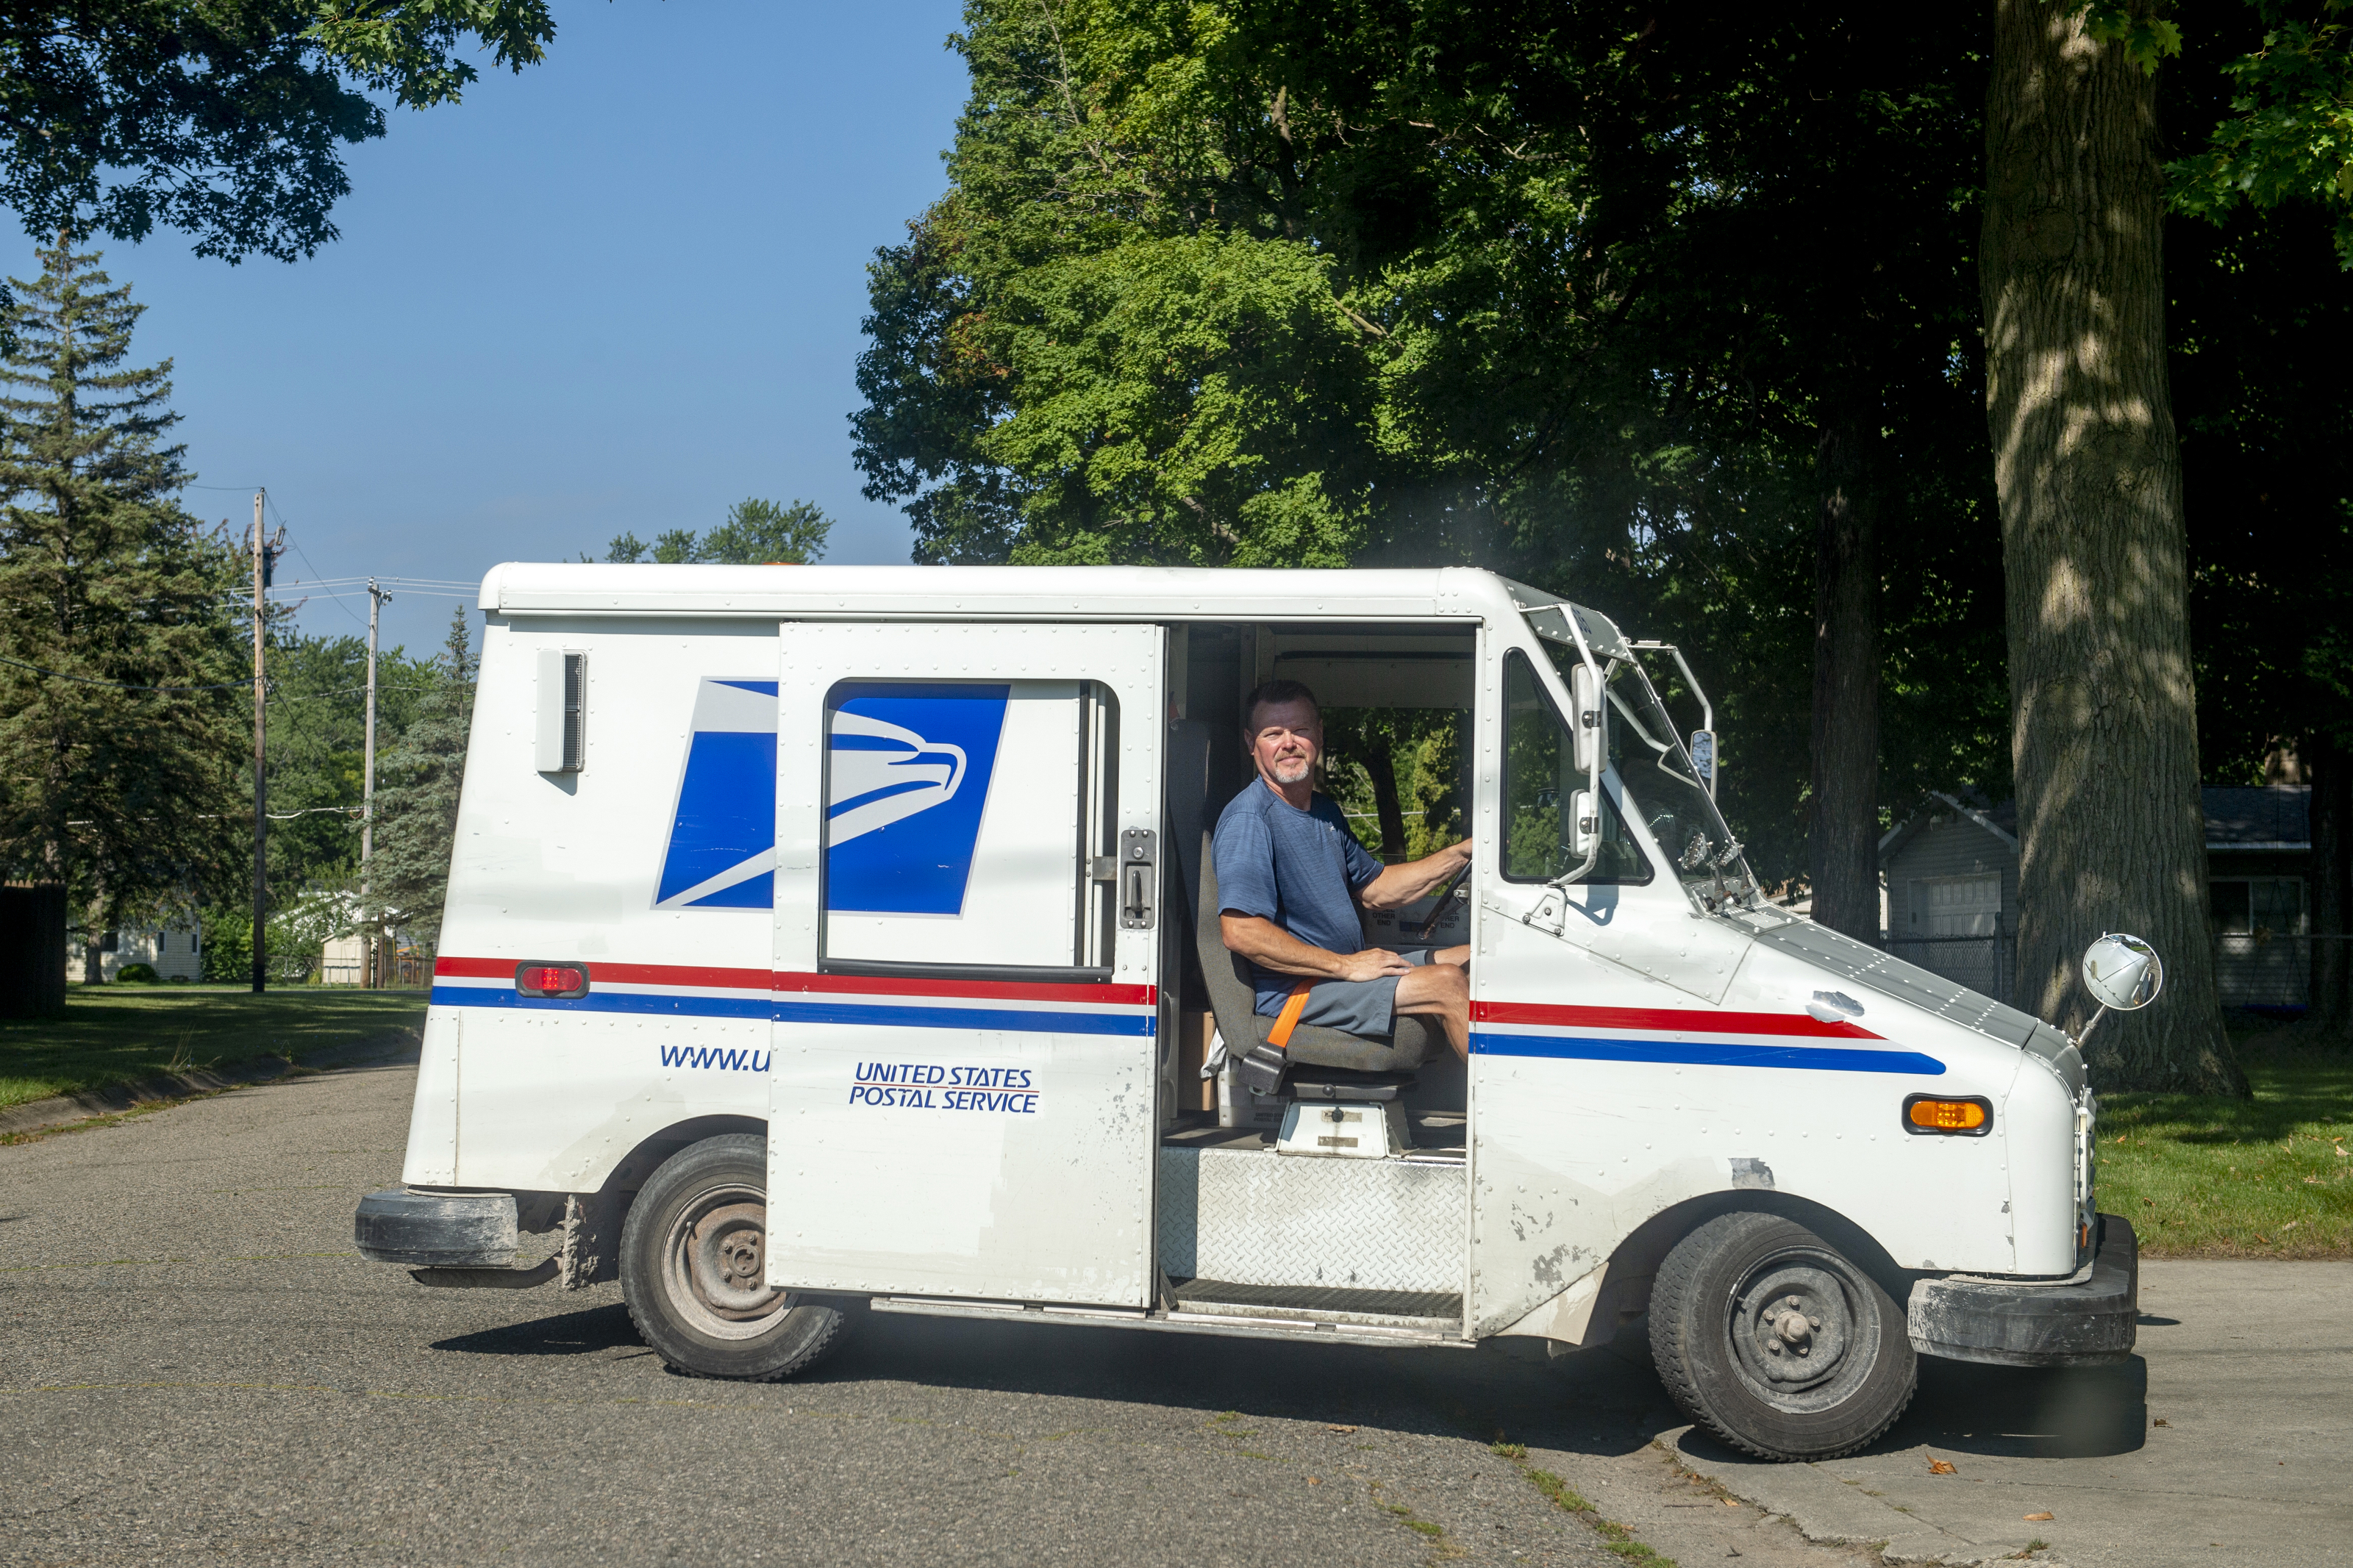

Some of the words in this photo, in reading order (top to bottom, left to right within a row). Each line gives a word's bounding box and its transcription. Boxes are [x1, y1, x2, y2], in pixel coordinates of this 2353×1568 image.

[1372, 912, 1396, 920] OTHER
[855, 1062, 945, 1084] UNITED
[949, 1067, 1032, 1088] STATES
[849, 1086, 937, 1109] POSTAL
[941, 1090, 1039, 1114] SERVICE
